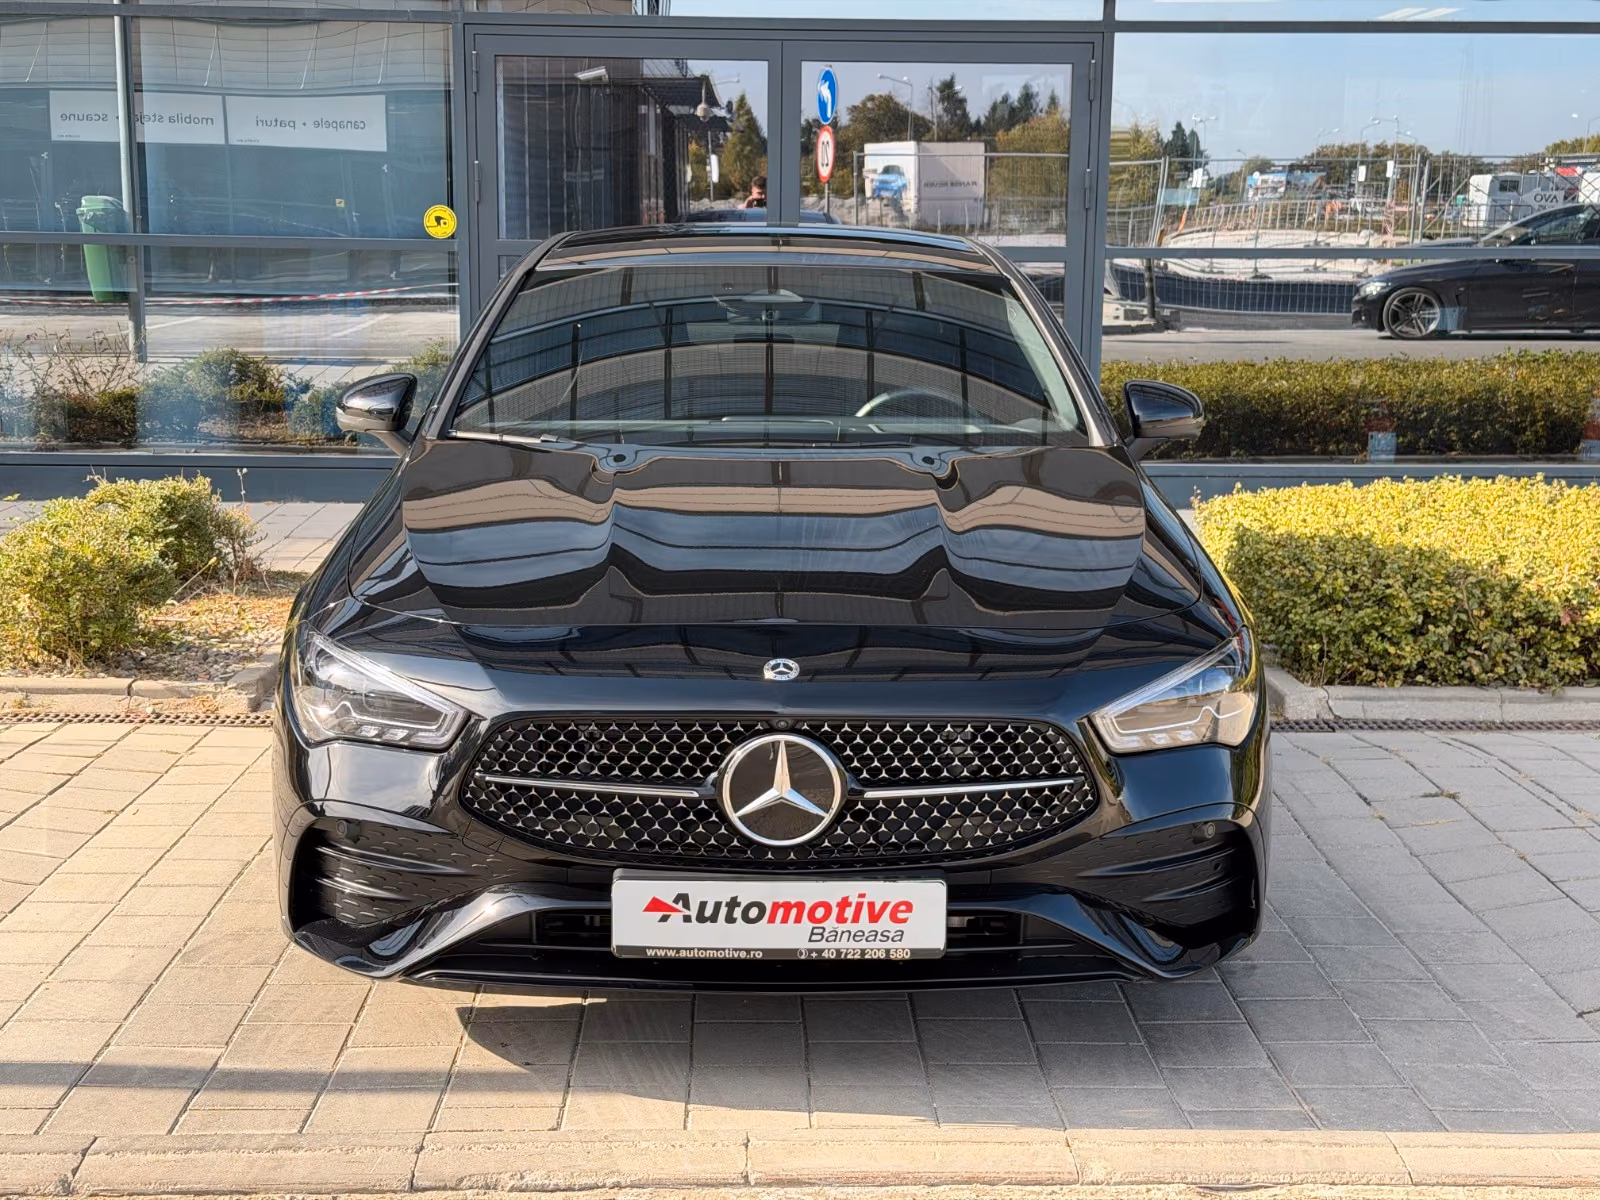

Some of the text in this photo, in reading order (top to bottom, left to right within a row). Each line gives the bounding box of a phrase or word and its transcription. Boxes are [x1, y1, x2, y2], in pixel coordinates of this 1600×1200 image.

[656, 892, 914, 925] Automotive
[807, 926, 905, 943] Băneasa
[645, 948, 763, 959] www.automotive.ro
[821, 948, 837, 959] 40
[839, 948, 861, 959] 722
[864, 948, 886, 959] 206
[889, 948, 911, 959] 580
